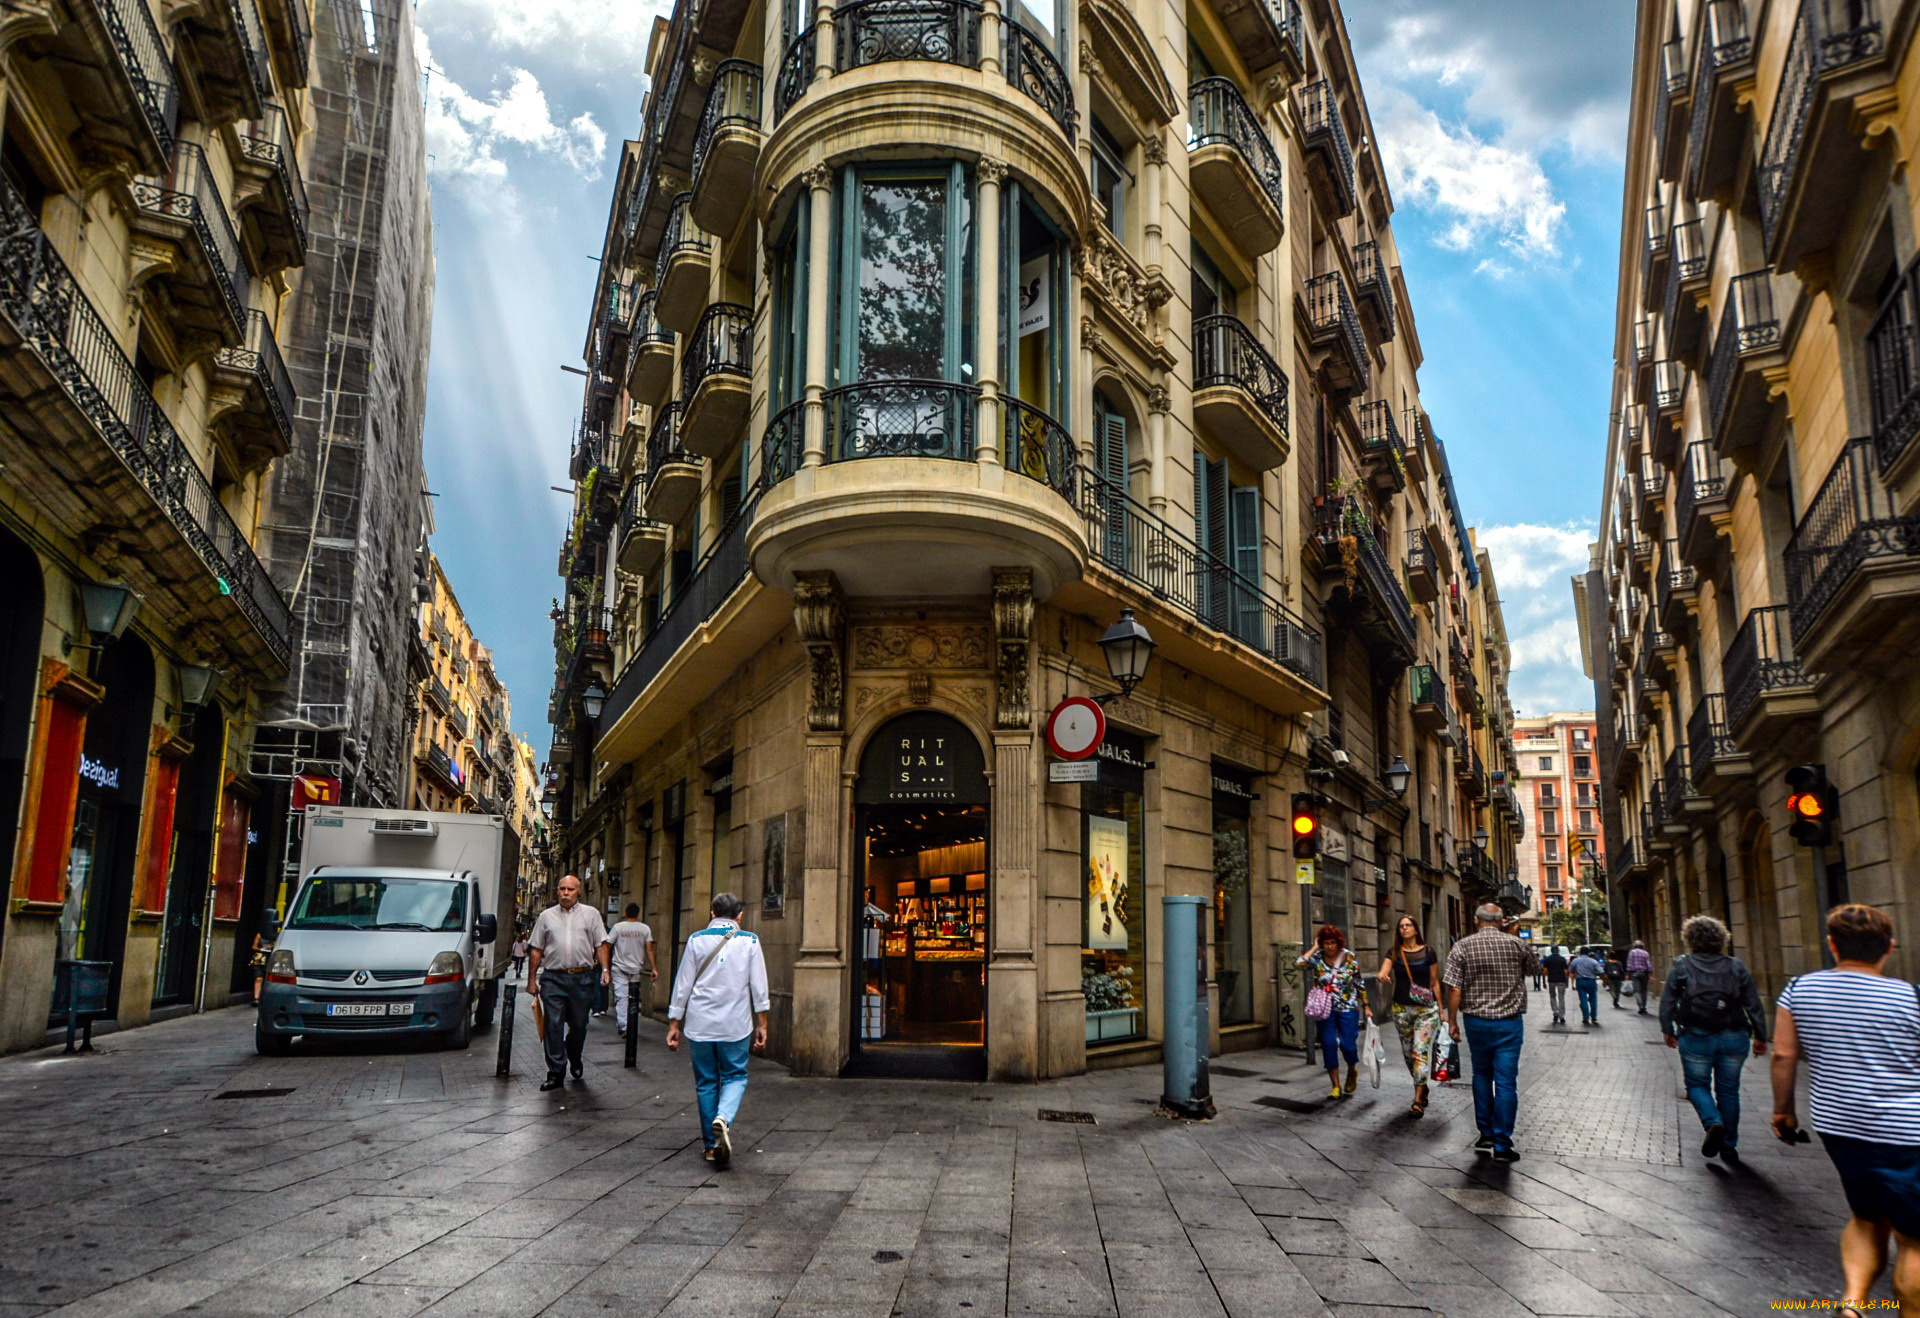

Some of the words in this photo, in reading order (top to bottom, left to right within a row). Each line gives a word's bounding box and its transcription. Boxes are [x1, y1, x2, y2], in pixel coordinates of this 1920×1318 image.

[901, 739, 945, 749] RIT
[901, 755, 945, 767] UAL
[889, 791, 956, 799] cosmetics
[335, 1005, 361, 1015] 0619
[363, 1005, 383, 1014] FPP
